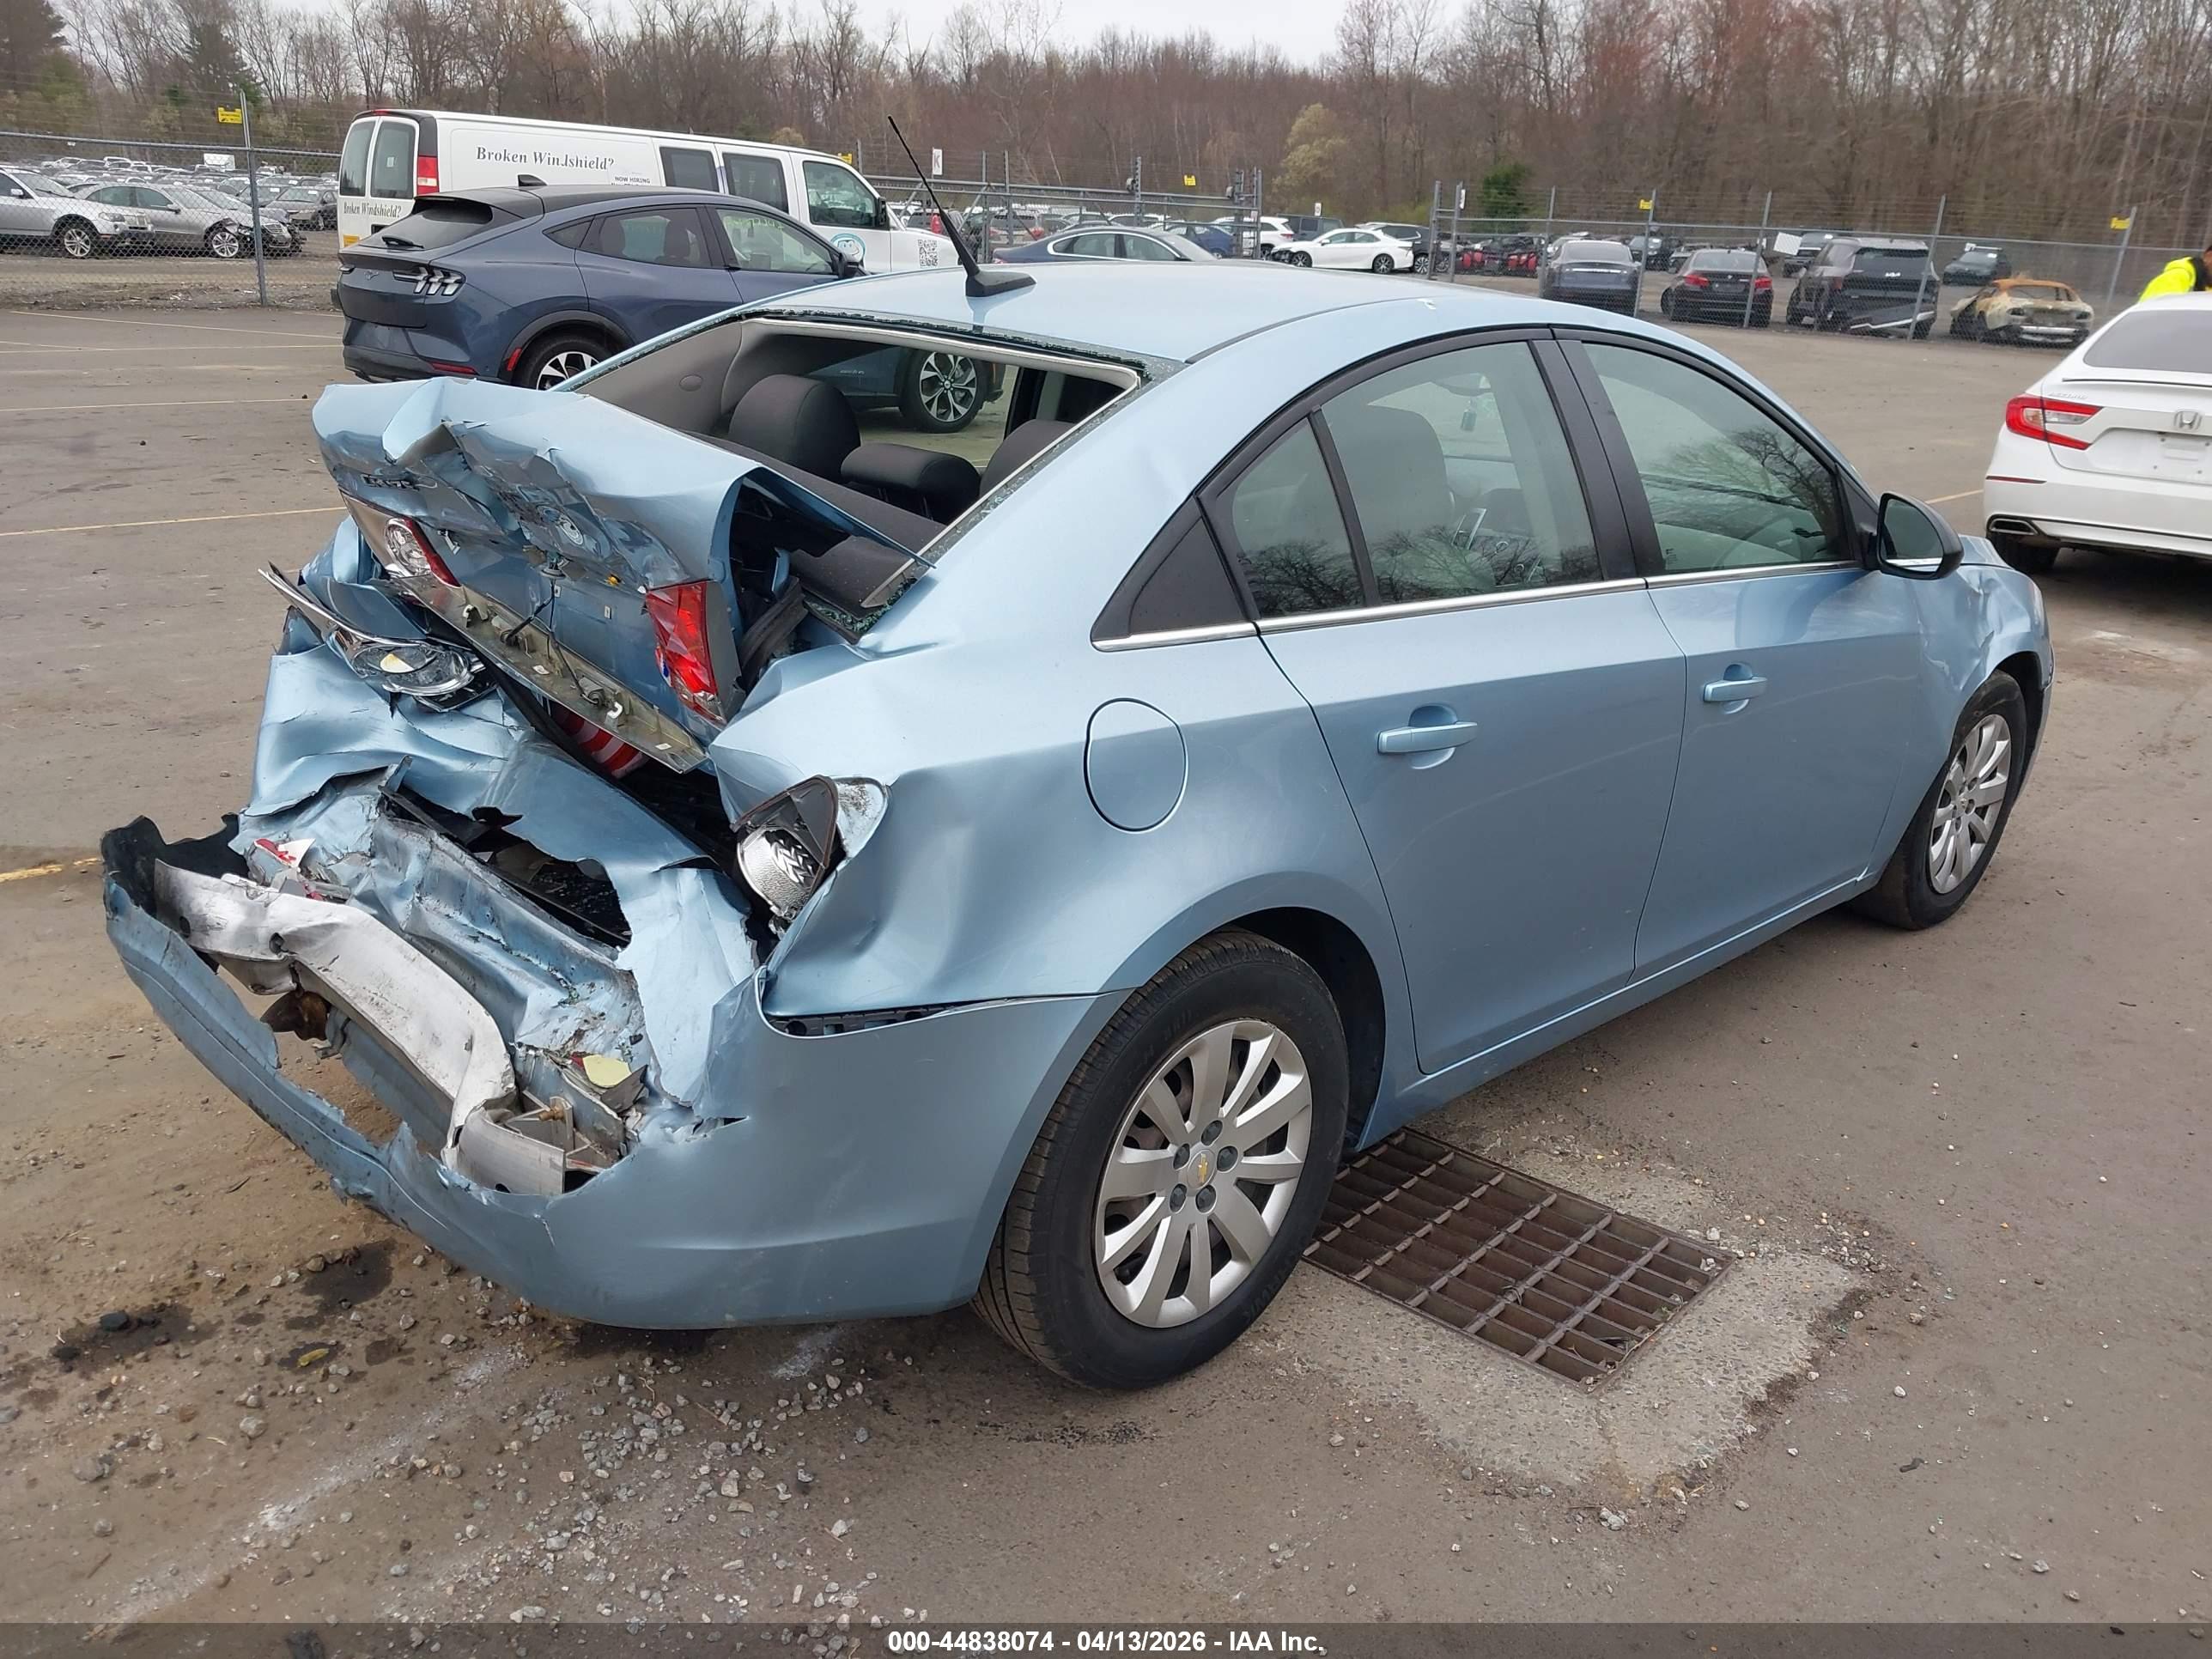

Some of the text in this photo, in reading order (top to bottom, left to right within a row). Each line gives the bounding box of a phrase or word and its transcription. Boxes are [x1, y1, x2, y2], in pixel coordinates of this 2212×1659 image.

[476, 146, 527, 164] Broken
[343, 201, 402, 218] Broken Windshield?
